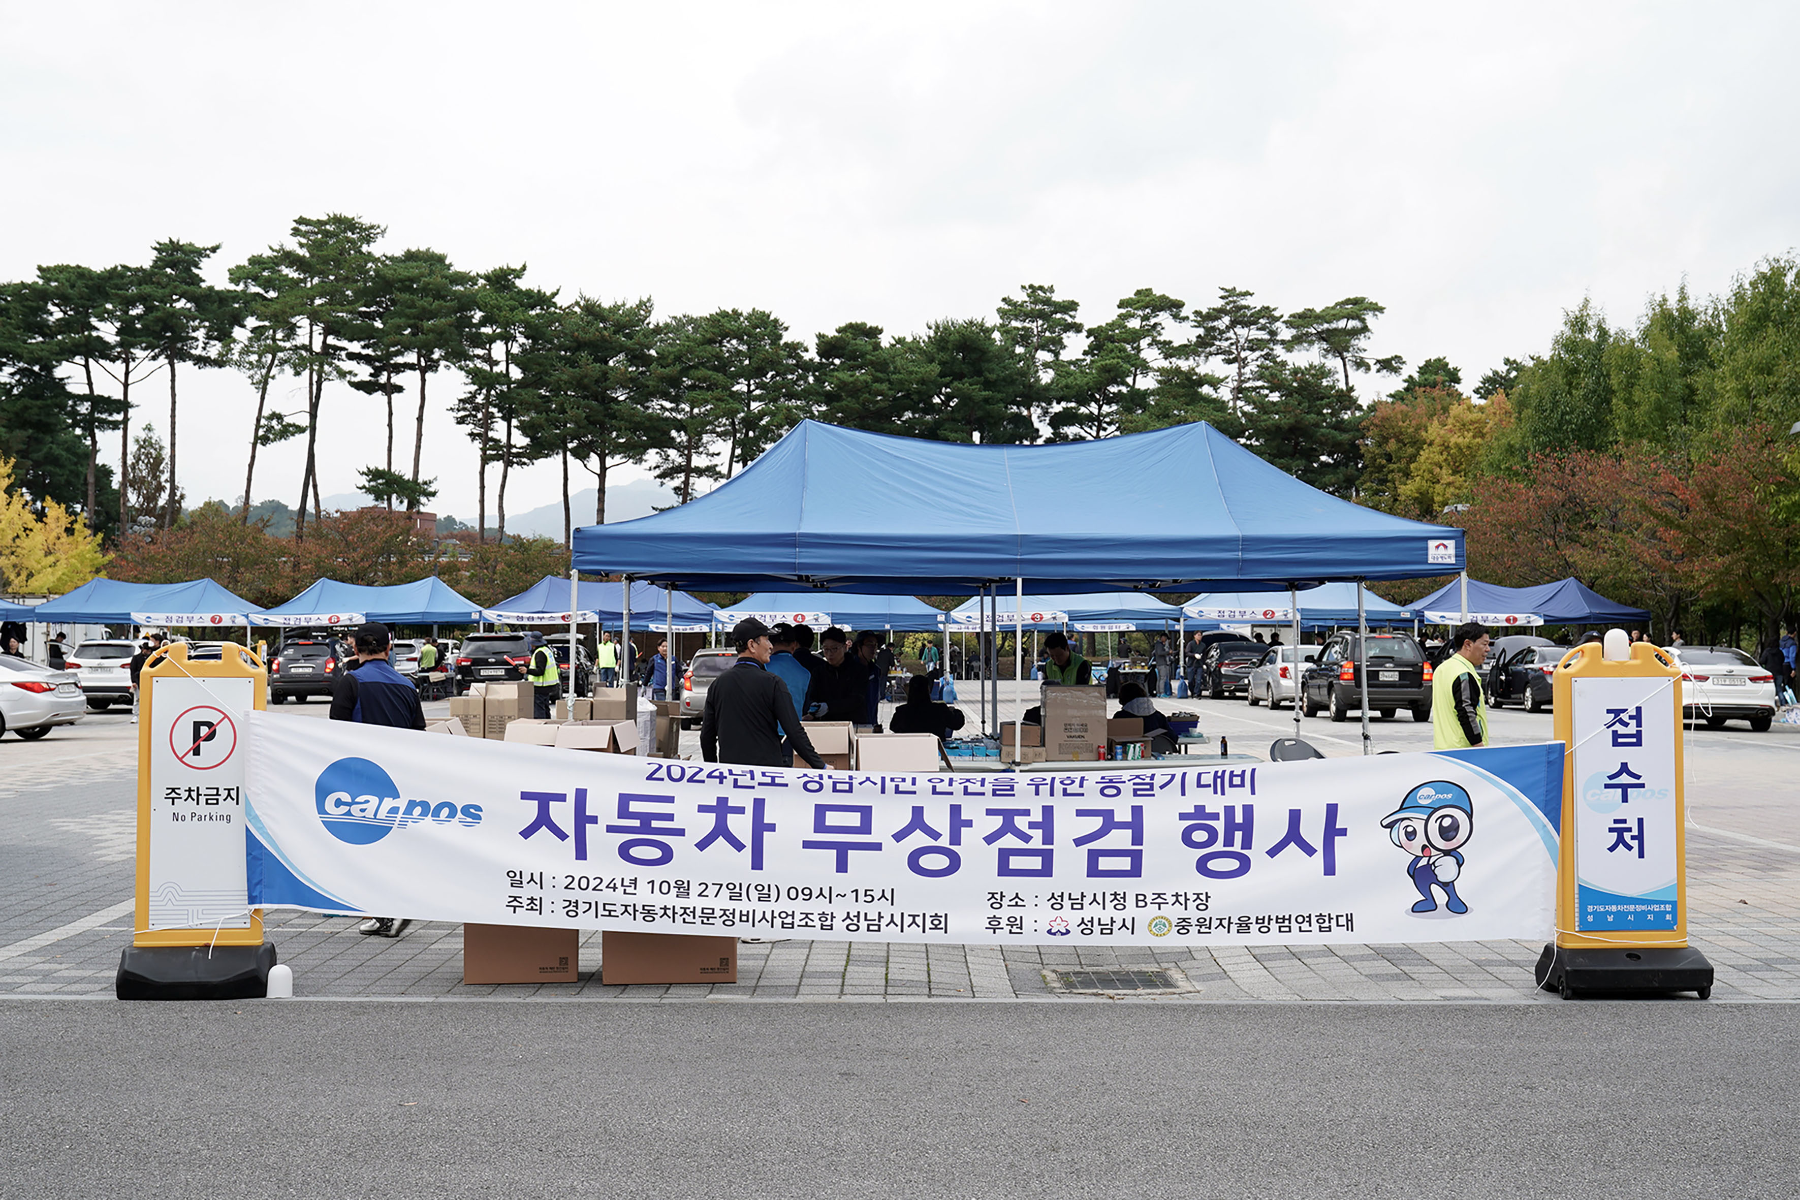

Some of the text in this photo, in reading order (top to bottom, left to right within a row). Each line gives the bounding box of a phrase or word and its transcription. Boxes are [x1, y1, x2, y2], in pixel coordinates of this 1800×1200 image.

[165, 615, 205, 623] 점검부스
[1217, 610, 1257, 618] 점검부스
[645, 763, 1256, 797] 2024년도 성남시민 안전을 위한 동절기 대비
[1604, 706, 1646, 859] 접수처
[164, 786, 240, 806] 주차금지
[172, 812, 231, 824] No Parking
[518, 787, 1348, 880] 자동차 무상점검 행사
[506, 870, 544, 890] 일시
[564, 875, 638, 896] 2024년
[646, 879, 691, 899] 10월
[698, 881, 781, 903] 27일(일)
[786, 886, 895, 907] 09시~15시
[986, 890, 1027, 910] 장소
[1046, 891, 1127, 911] 성남시청
[1135, 892, 1212, 912] B주차장
[506, 896, 543, 916] 주최
[561, 897, 836, 931] 경기도자동차전문정비사업조합
[841, 911, 948, 935] 성남시지회
[985, 915, 1024, 935] 후원
[1076, 916, 1135, 936] 성남시
[1174, 912, 1354, 936] 중원자율방범연합대
